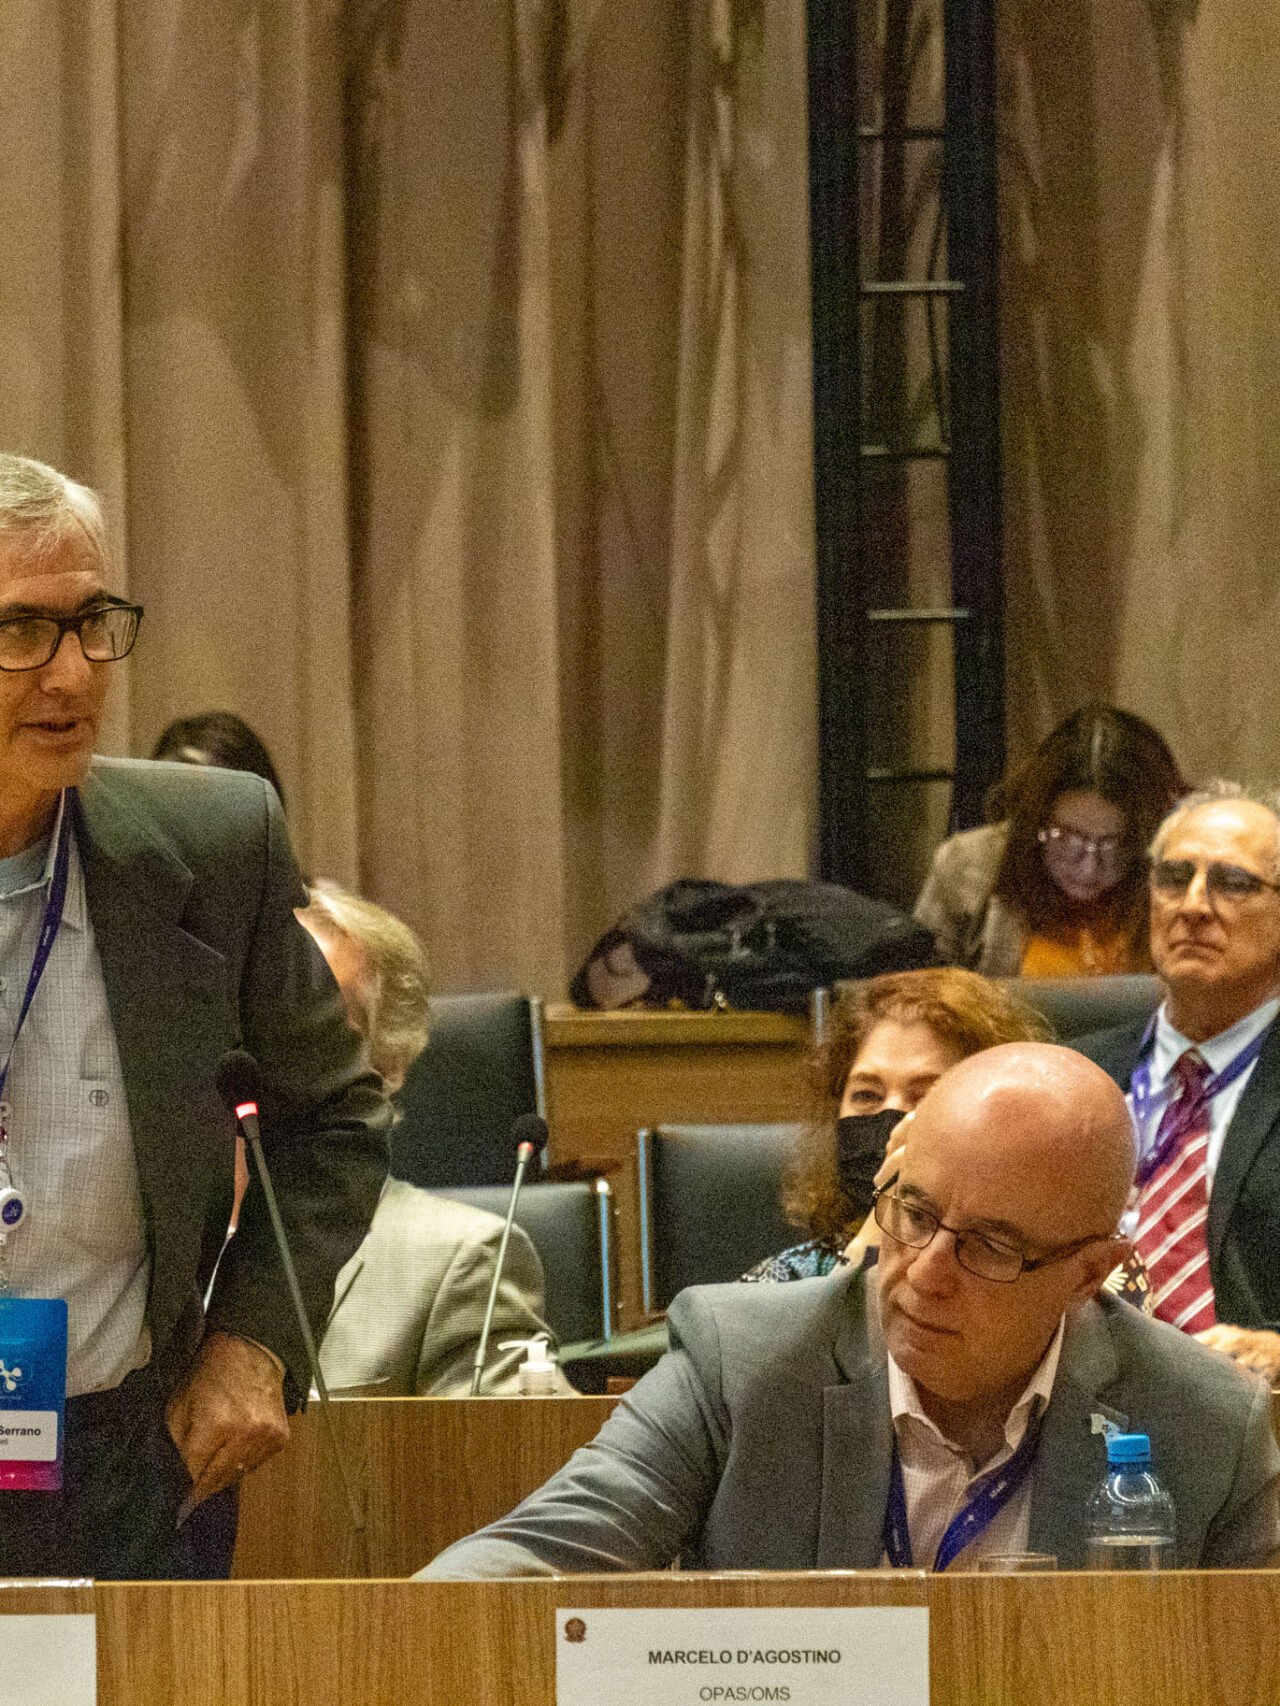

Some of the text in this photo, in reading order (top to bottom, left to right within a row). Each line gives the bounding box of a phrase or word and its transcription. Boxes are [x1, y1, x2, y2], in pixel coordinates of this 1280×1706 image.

[647, 1649, 843, 1665] MARCELO D'AGOSTINO
[699, 1686, 792, 1702] OPAS/OMS
